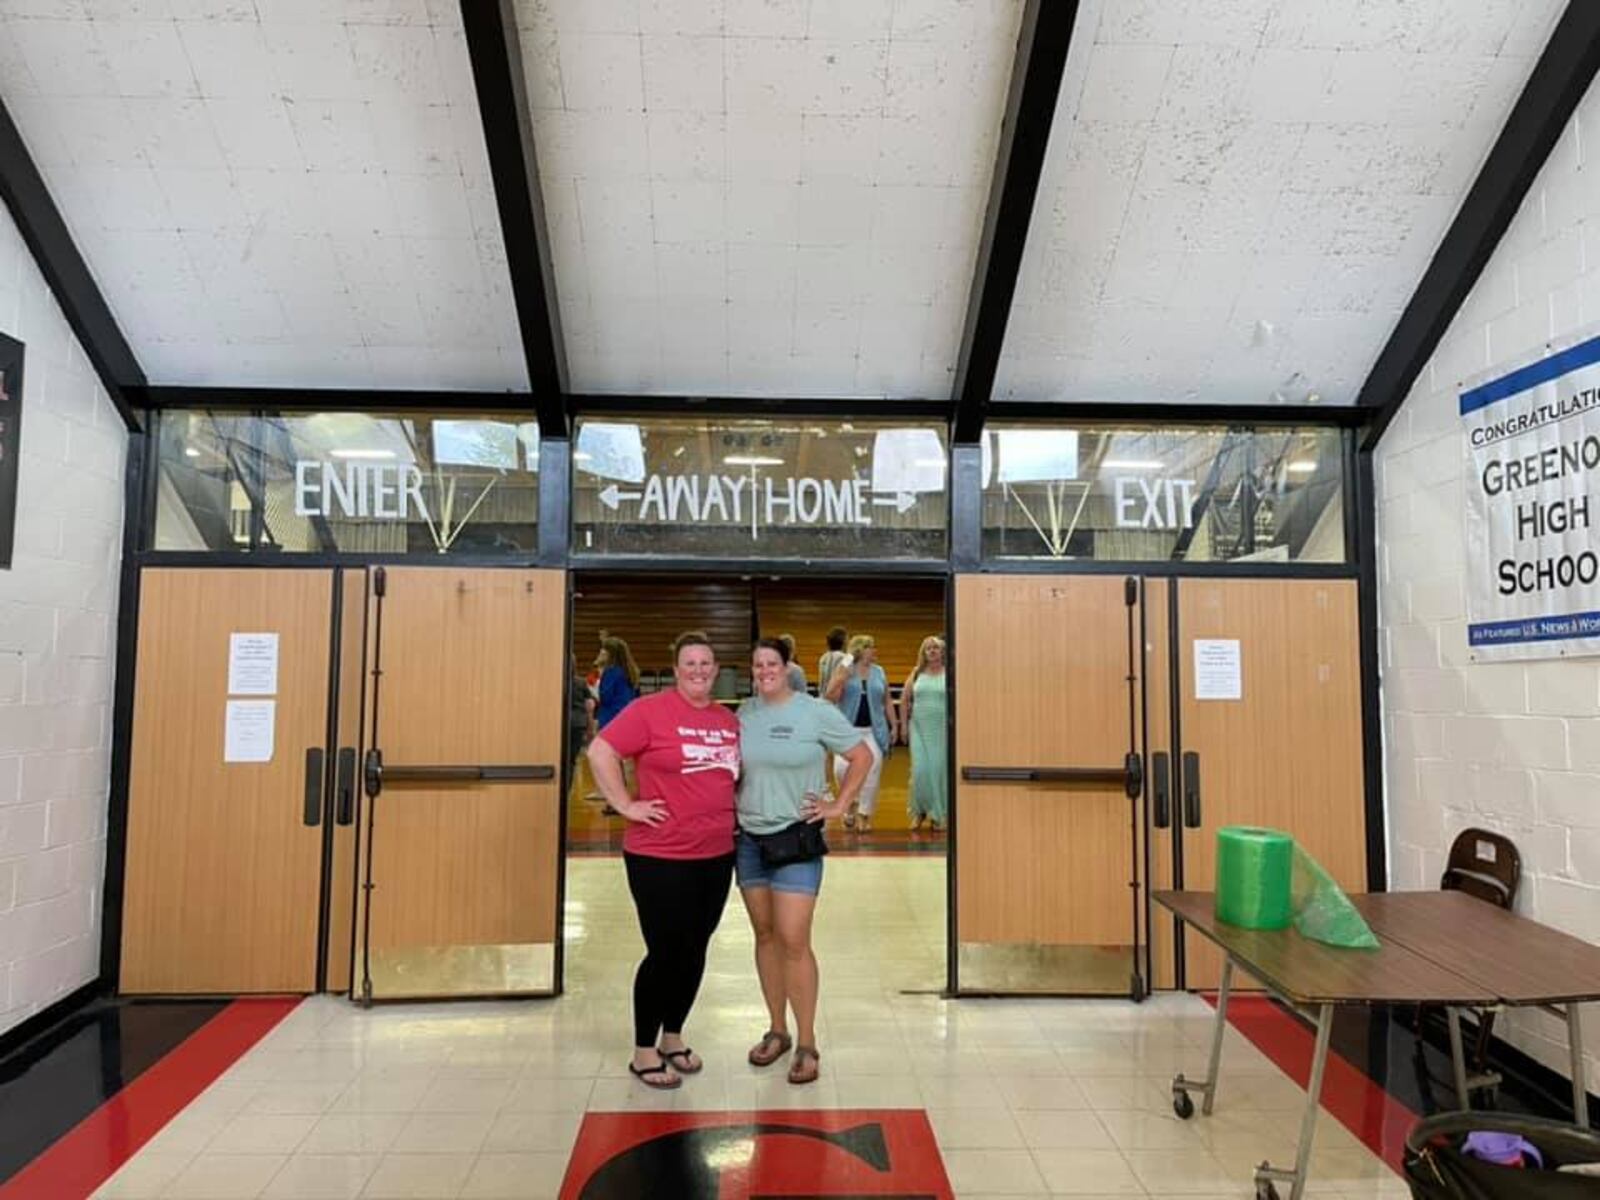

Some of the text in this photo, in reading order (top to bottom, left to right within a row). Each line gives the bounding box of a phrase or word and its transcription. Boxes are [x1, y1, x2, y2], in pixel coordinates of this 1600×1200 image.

[294, 460, 430, 521] ENTER
[1482, 435, 1600, 496] GREENO
[639, 474, 872, 525] AWAY HOME
[1115, 478, 1196, 528] EXIT
[1518, 495, 1590, 541] HIGH
[1498, 551, 1598, 596] SCHOO
